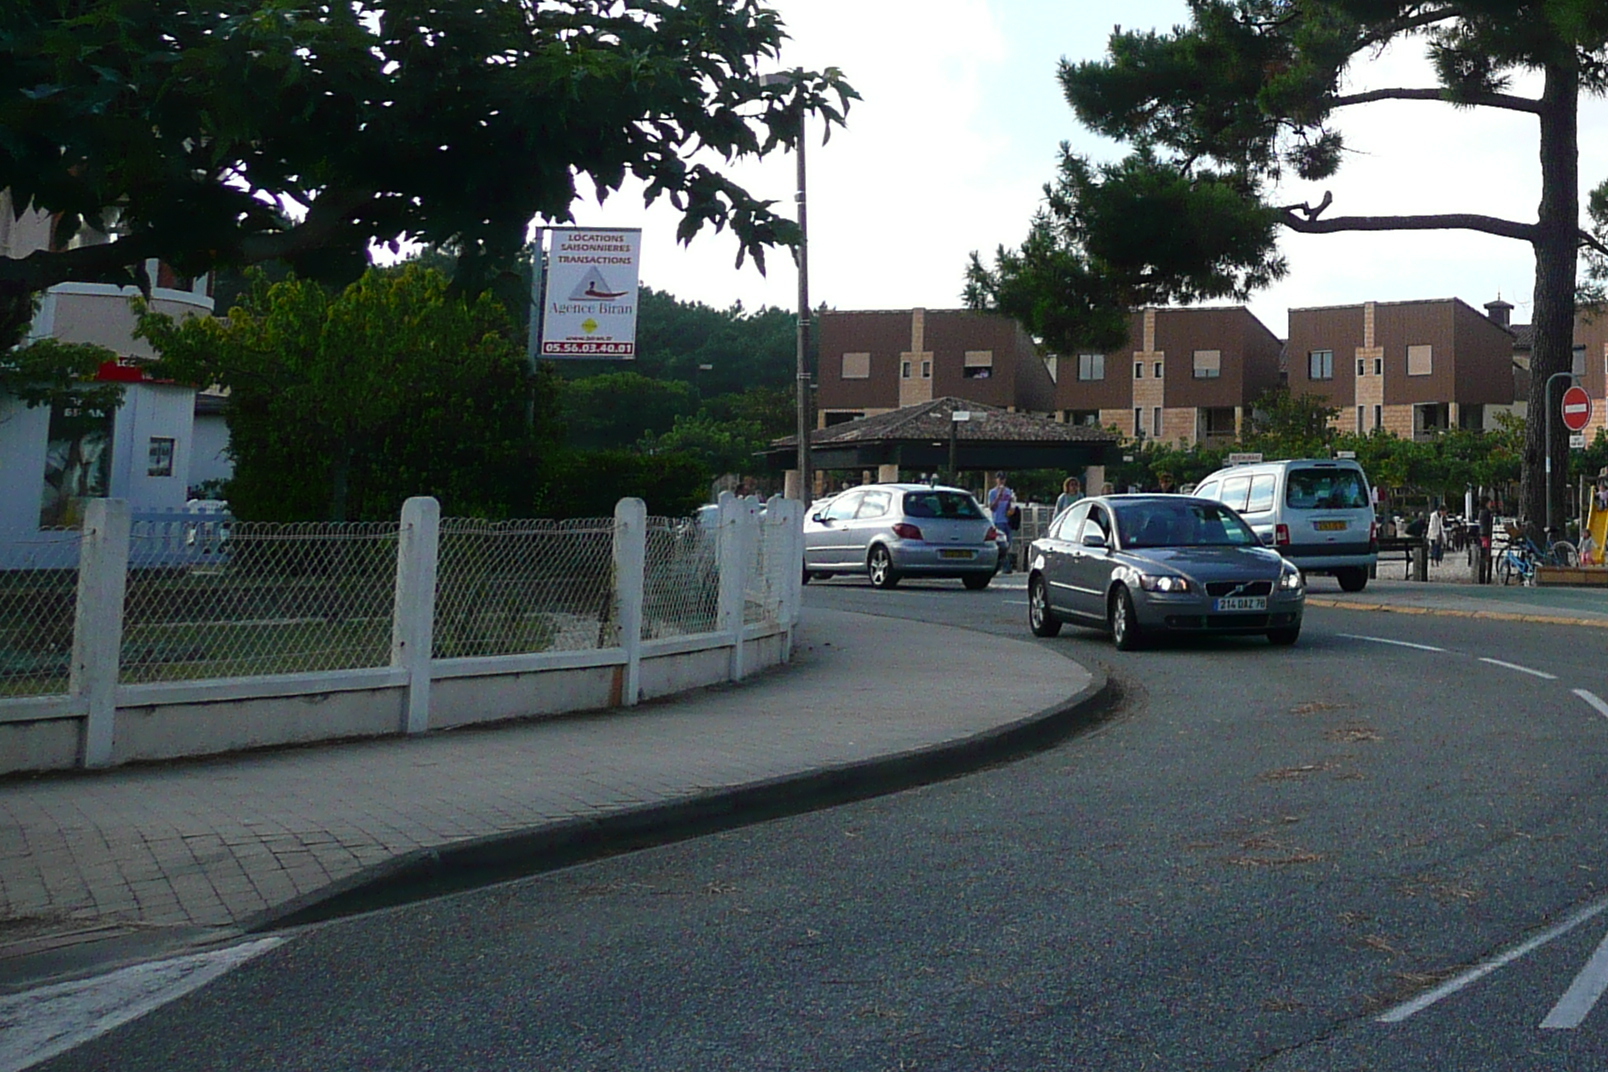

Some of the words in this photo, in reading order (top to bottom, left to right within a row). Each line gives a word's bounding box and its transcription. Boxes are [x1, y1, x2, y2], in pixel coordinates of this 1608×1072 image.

[568, 234, 624, 242] LOCATIONS
[561, 243, 630, 252] SAISONNIERES
[558, 255, 631, 264] TRANSACTIONS
[550, 302, 595, 314] Agence
[599, 302, 632, 314] Biran
[545, 343, 632, 353] 05.56.03.40.01
